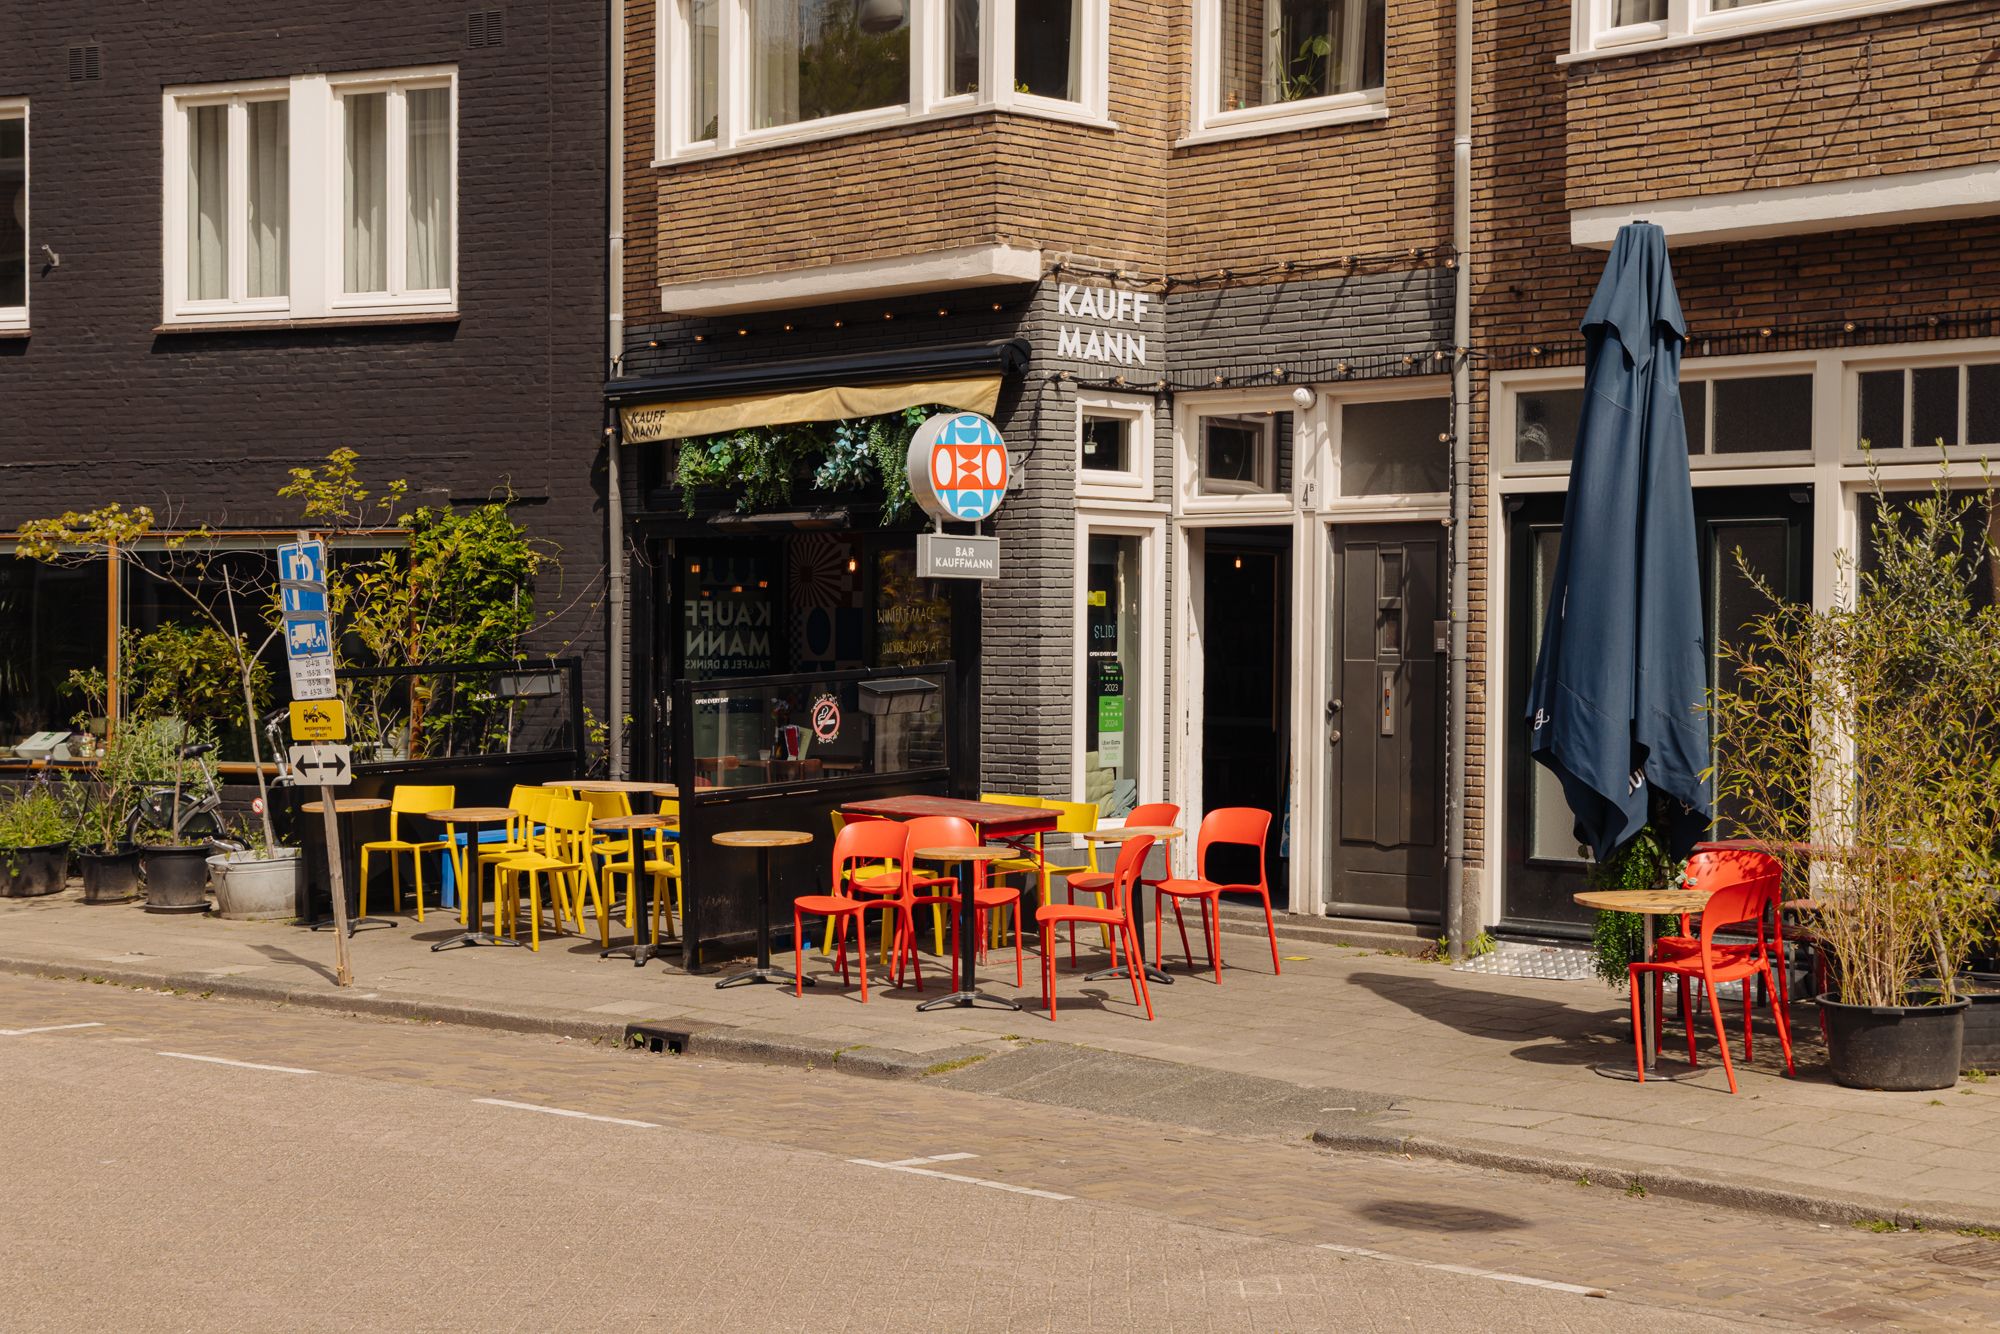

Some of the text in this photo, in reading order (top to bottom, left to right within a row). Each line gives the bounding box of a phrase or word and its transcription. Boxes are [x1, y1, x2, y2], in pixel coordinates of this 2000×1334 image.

[1058, 284, 1149, 324] KAUFF
[1057, 326, 1146, 366] MANN
[631, 410, 666, 424] KAUFF
[631, 424, 662, 438] MANN
[955, 546, 975, 557] BAR
[935, 556, 993, 569] KAUFFMANN
[289, 554, 314, 610] P
[1104, 683, 1119, 692] 2023
